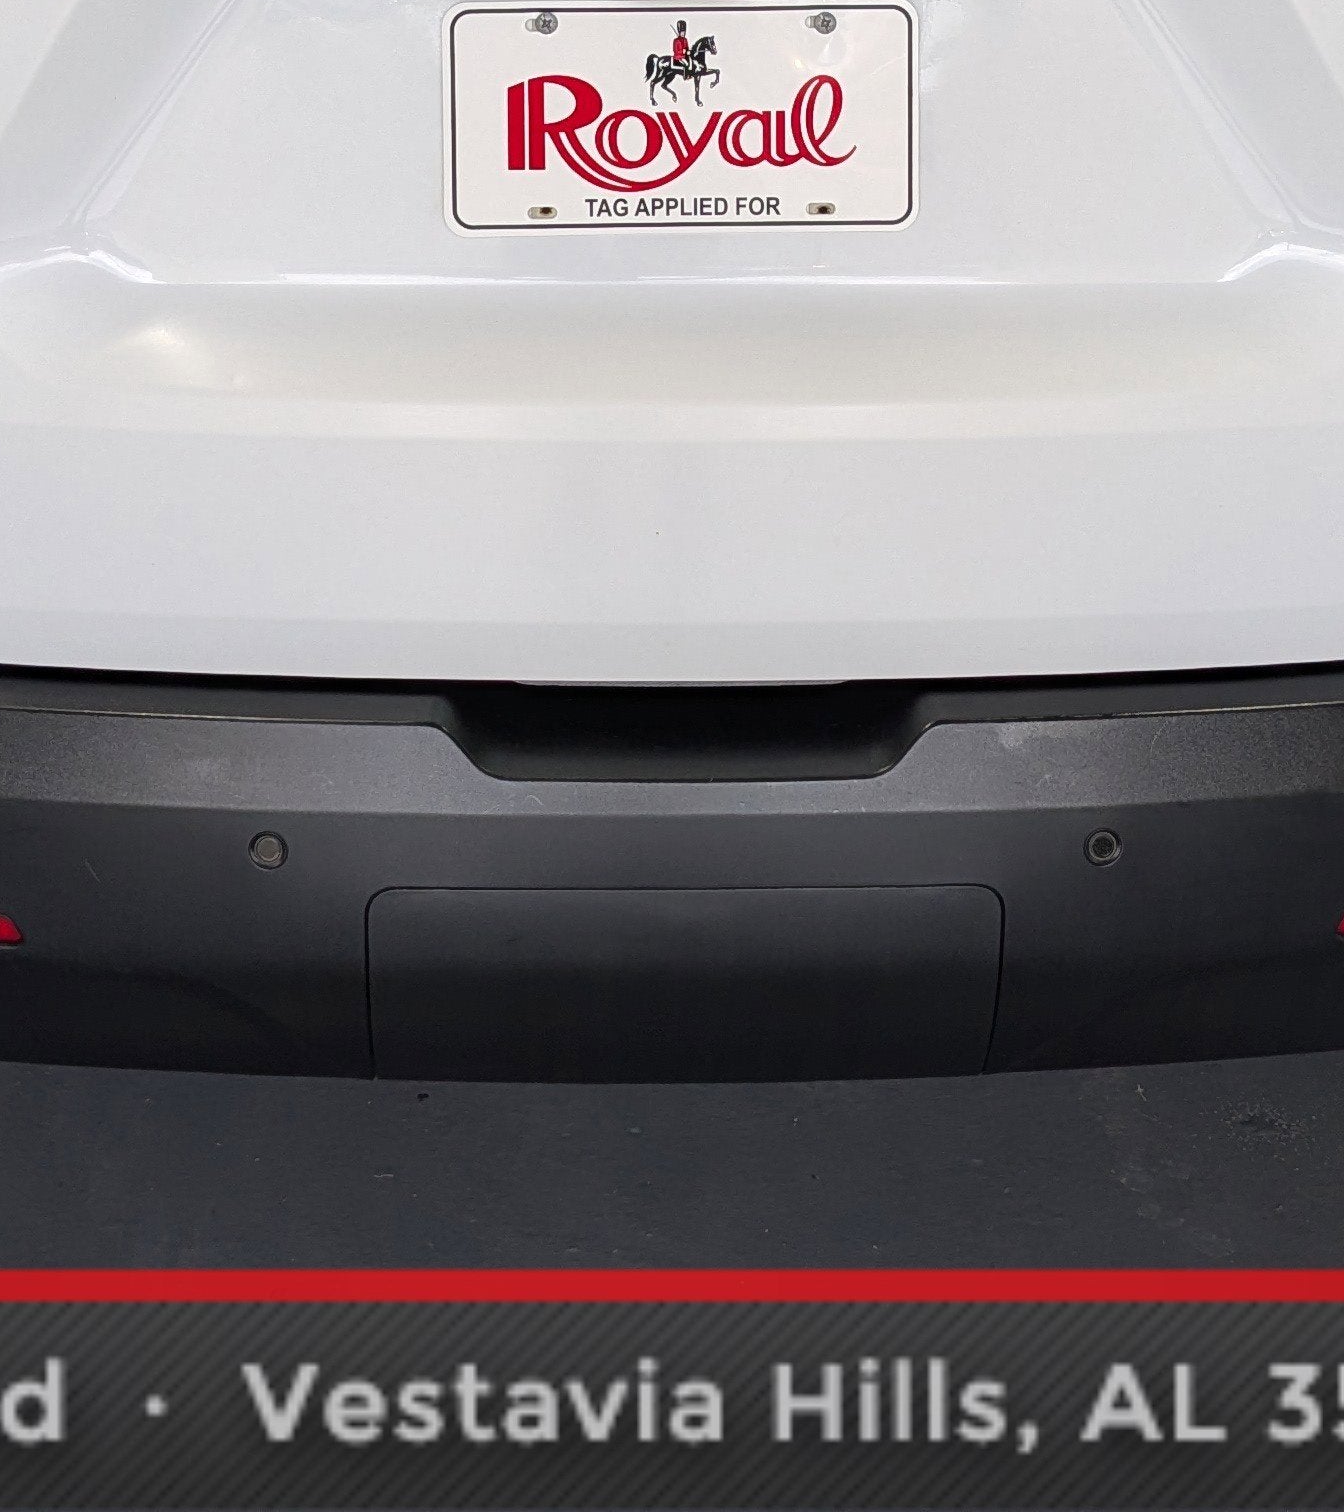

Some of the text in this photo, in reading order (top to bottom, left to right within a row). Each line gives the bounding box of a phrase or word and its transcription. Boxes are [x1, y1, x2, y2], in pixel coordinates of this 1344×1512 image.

[506, 74, 857, 193] Royal
[584, 196, 781, 217] TAG APPLIED FOR
